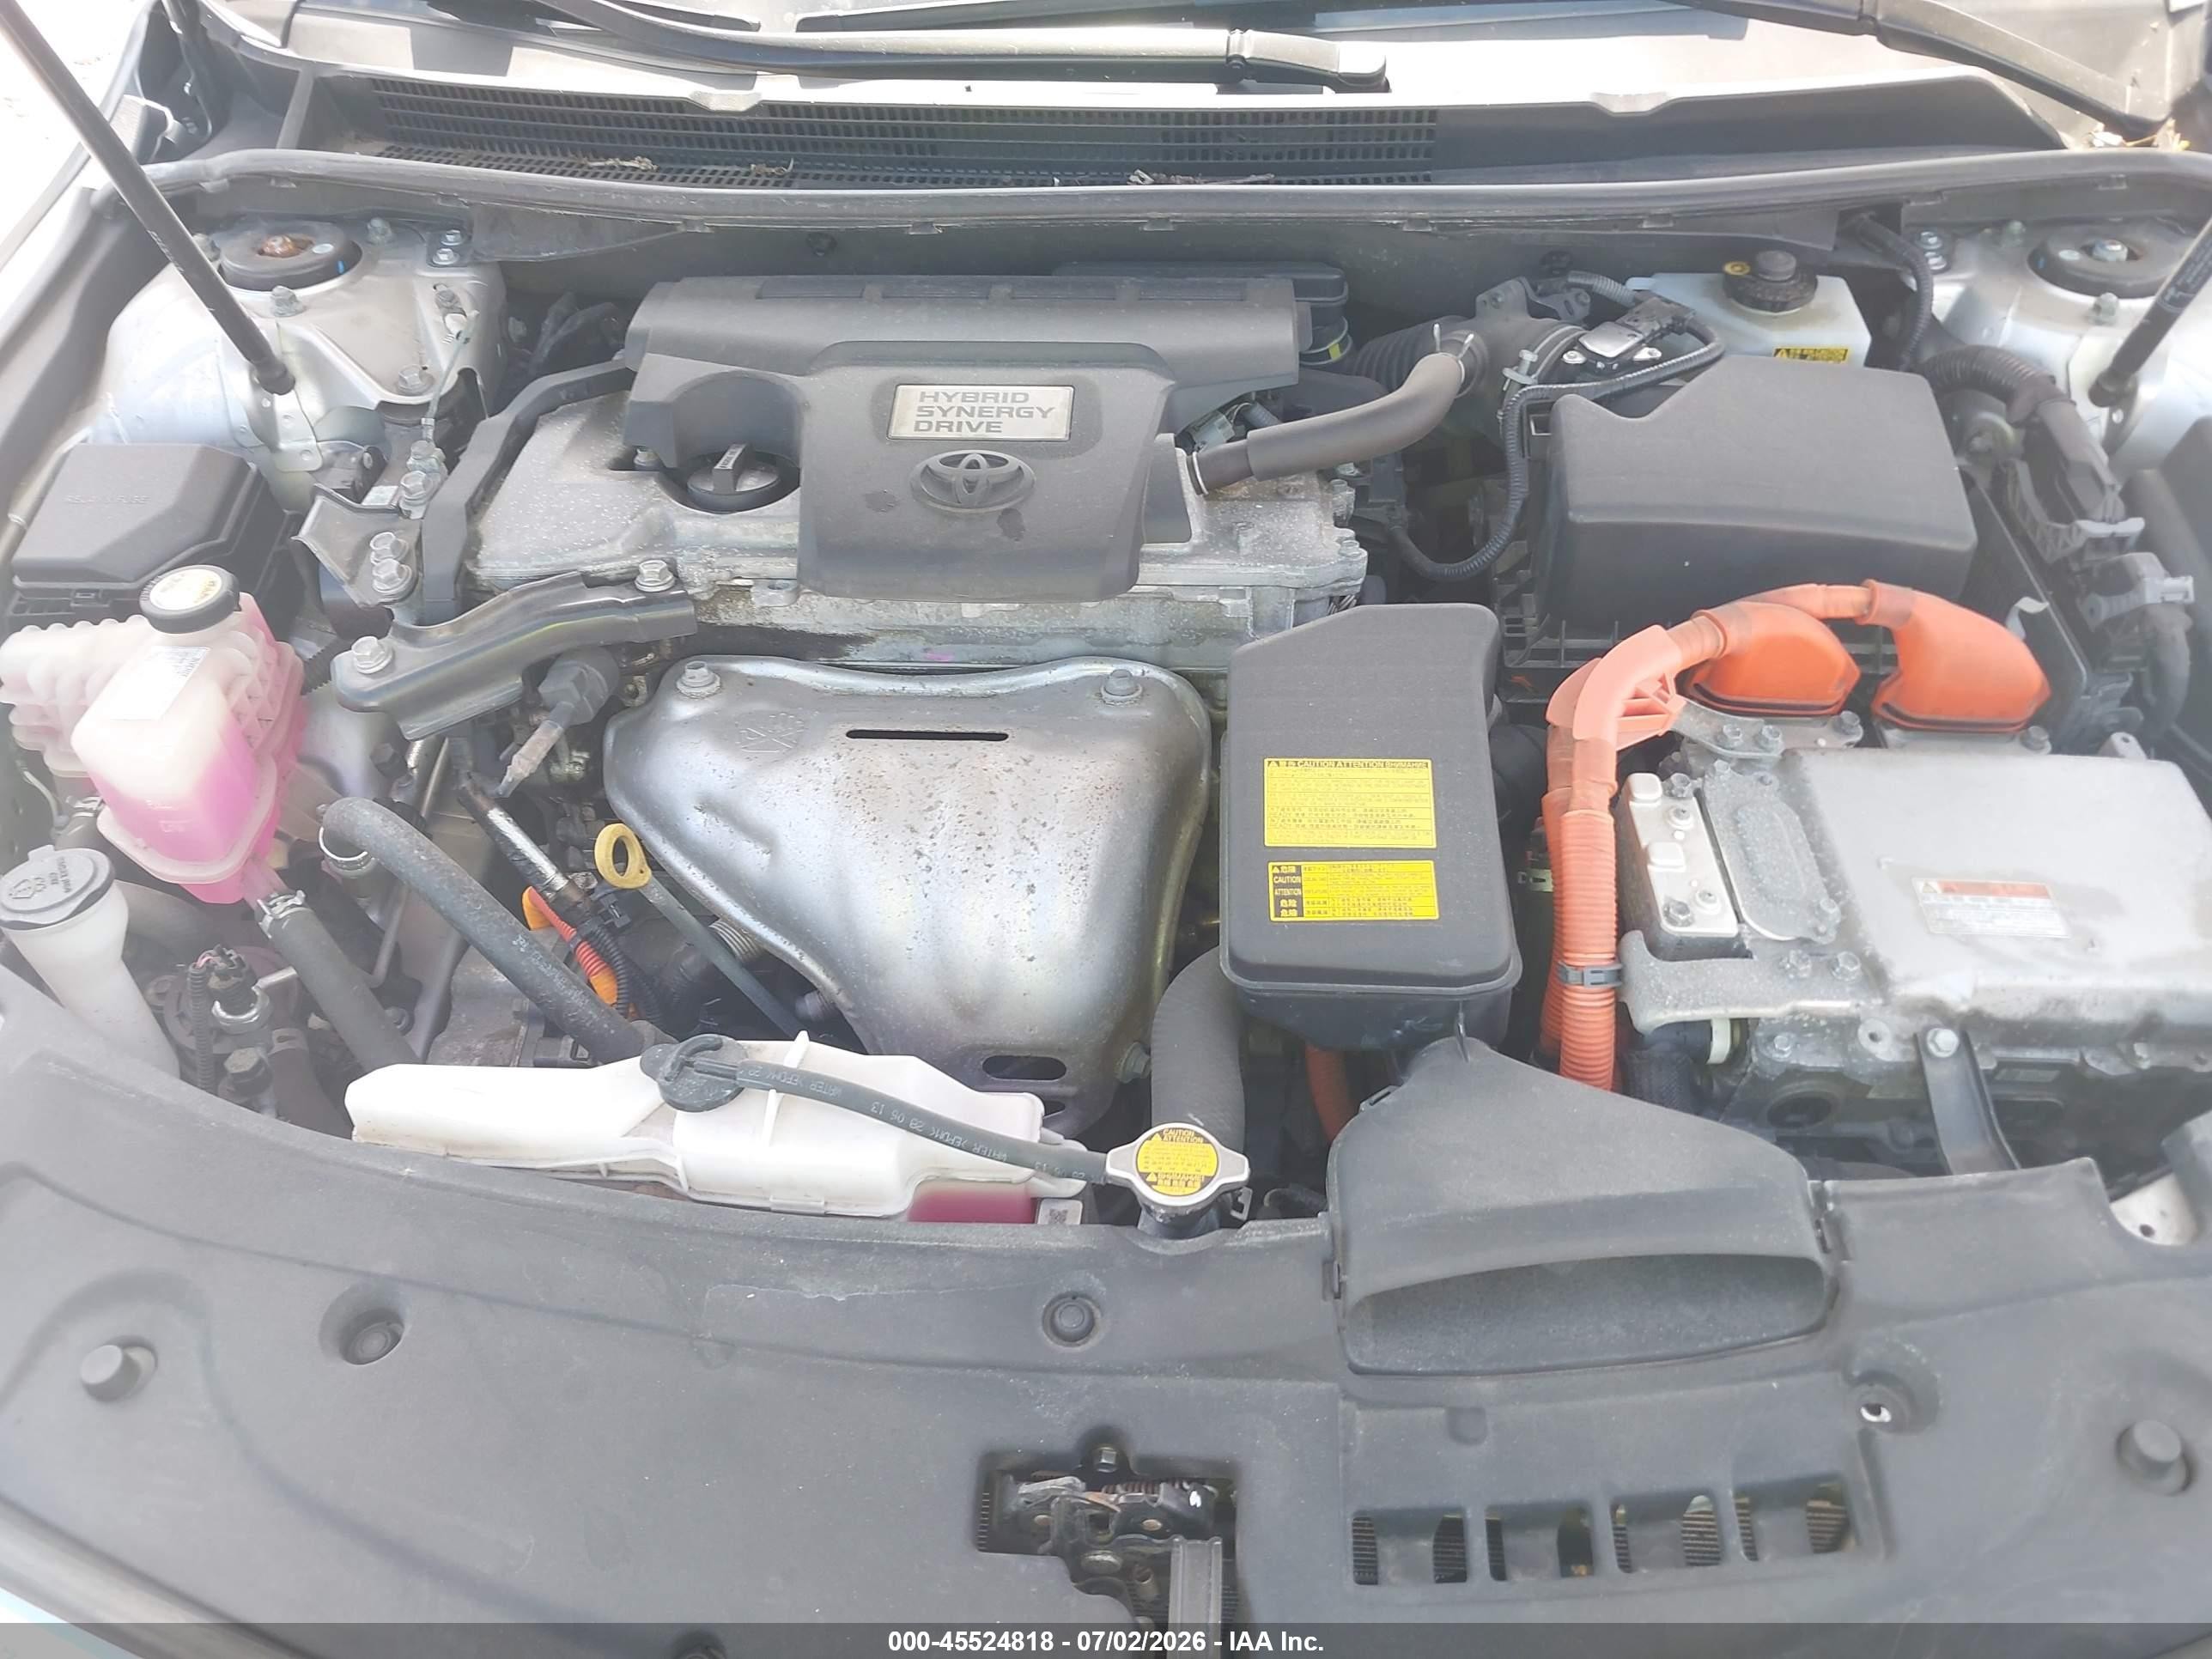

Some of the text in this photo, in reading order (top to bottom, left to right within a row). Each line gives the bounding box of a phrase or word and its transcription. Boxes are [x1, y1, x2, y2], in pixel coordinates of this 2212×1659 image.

[919, 391, 1030, 404] HYBRID
[916, 406, 1055, 418] SYNERGY
[914, 421, 1003, 433] DRIVE
[1297, 760, 1334, 769] CAUTION
[1273, 876, 1302, 884] CAUTION
